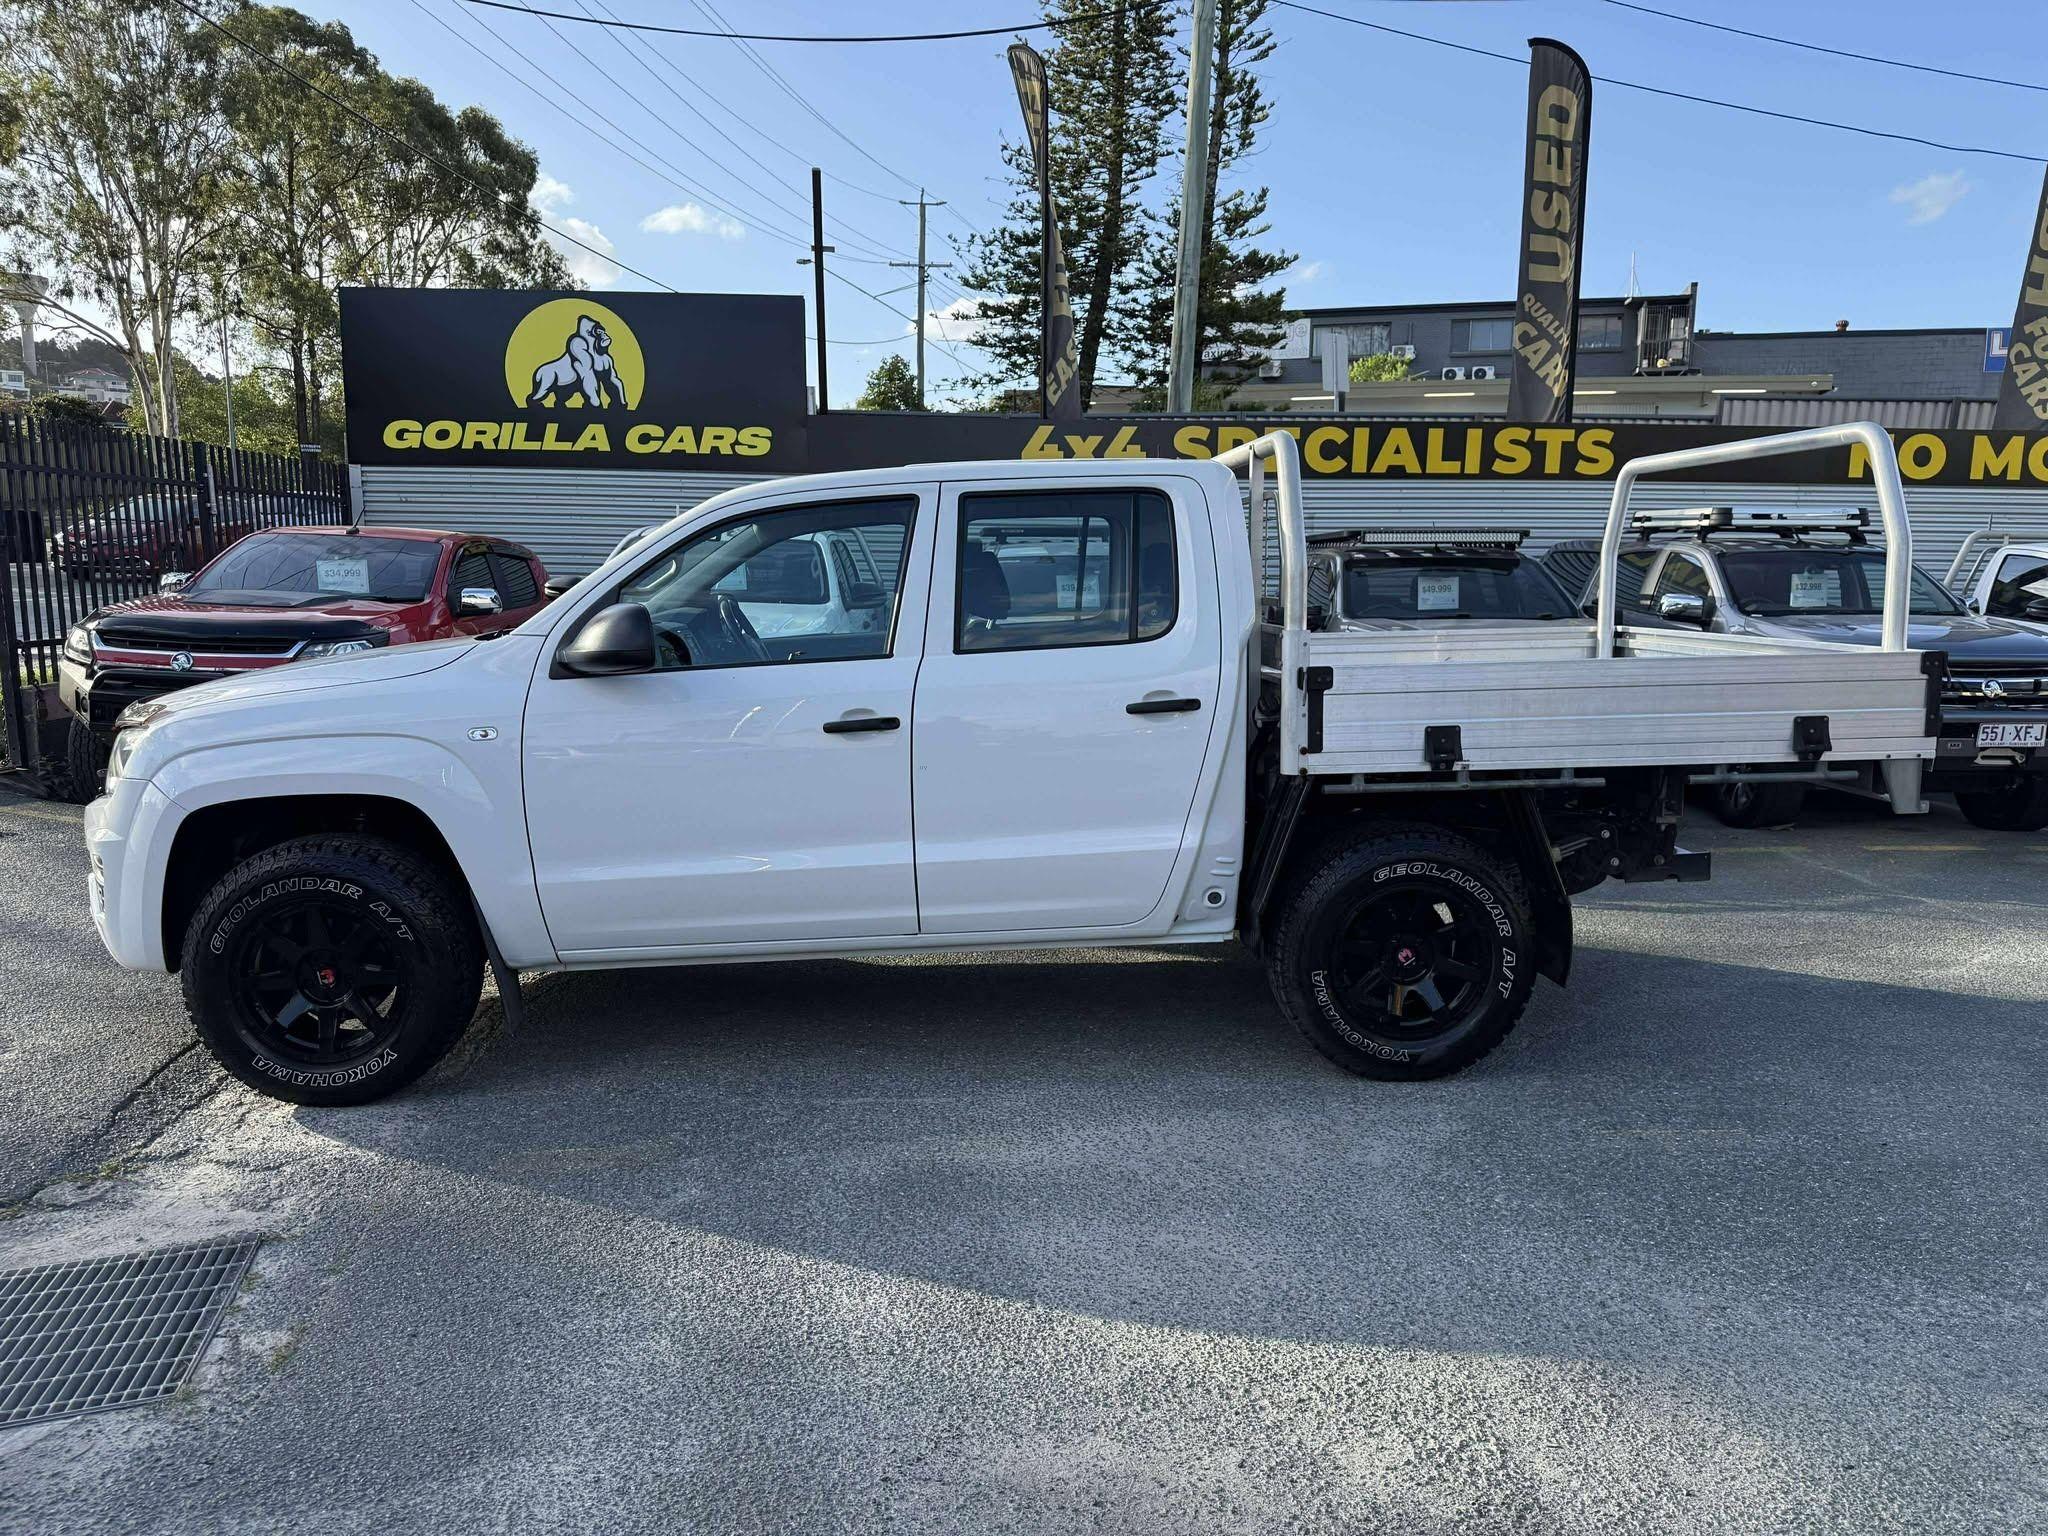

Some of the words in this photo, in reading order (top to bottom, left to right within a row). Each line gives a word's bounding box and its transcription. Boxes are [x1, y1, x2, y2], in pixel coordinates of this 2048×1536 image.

[1528, 84, 1578, 283] USED
[1523, 293, 1570, 350] QUALI
[382, 420, 611, 452] GORILLA
[625, 424, 773, 456] CARS
[1021, 425, 1145, 460] 4x4
[210, 877, 362, 954] GEOLANDAR
[369, 901, 415, 942] A/T
[1373, 862, 1513, 938] GEOLANDAR
[1498, 946, 1516, 1000] A/T
[1311, 970, 1410, 1063] YOKOHAMA
[251, 1048, 398, 1087] YOKOHAMA
